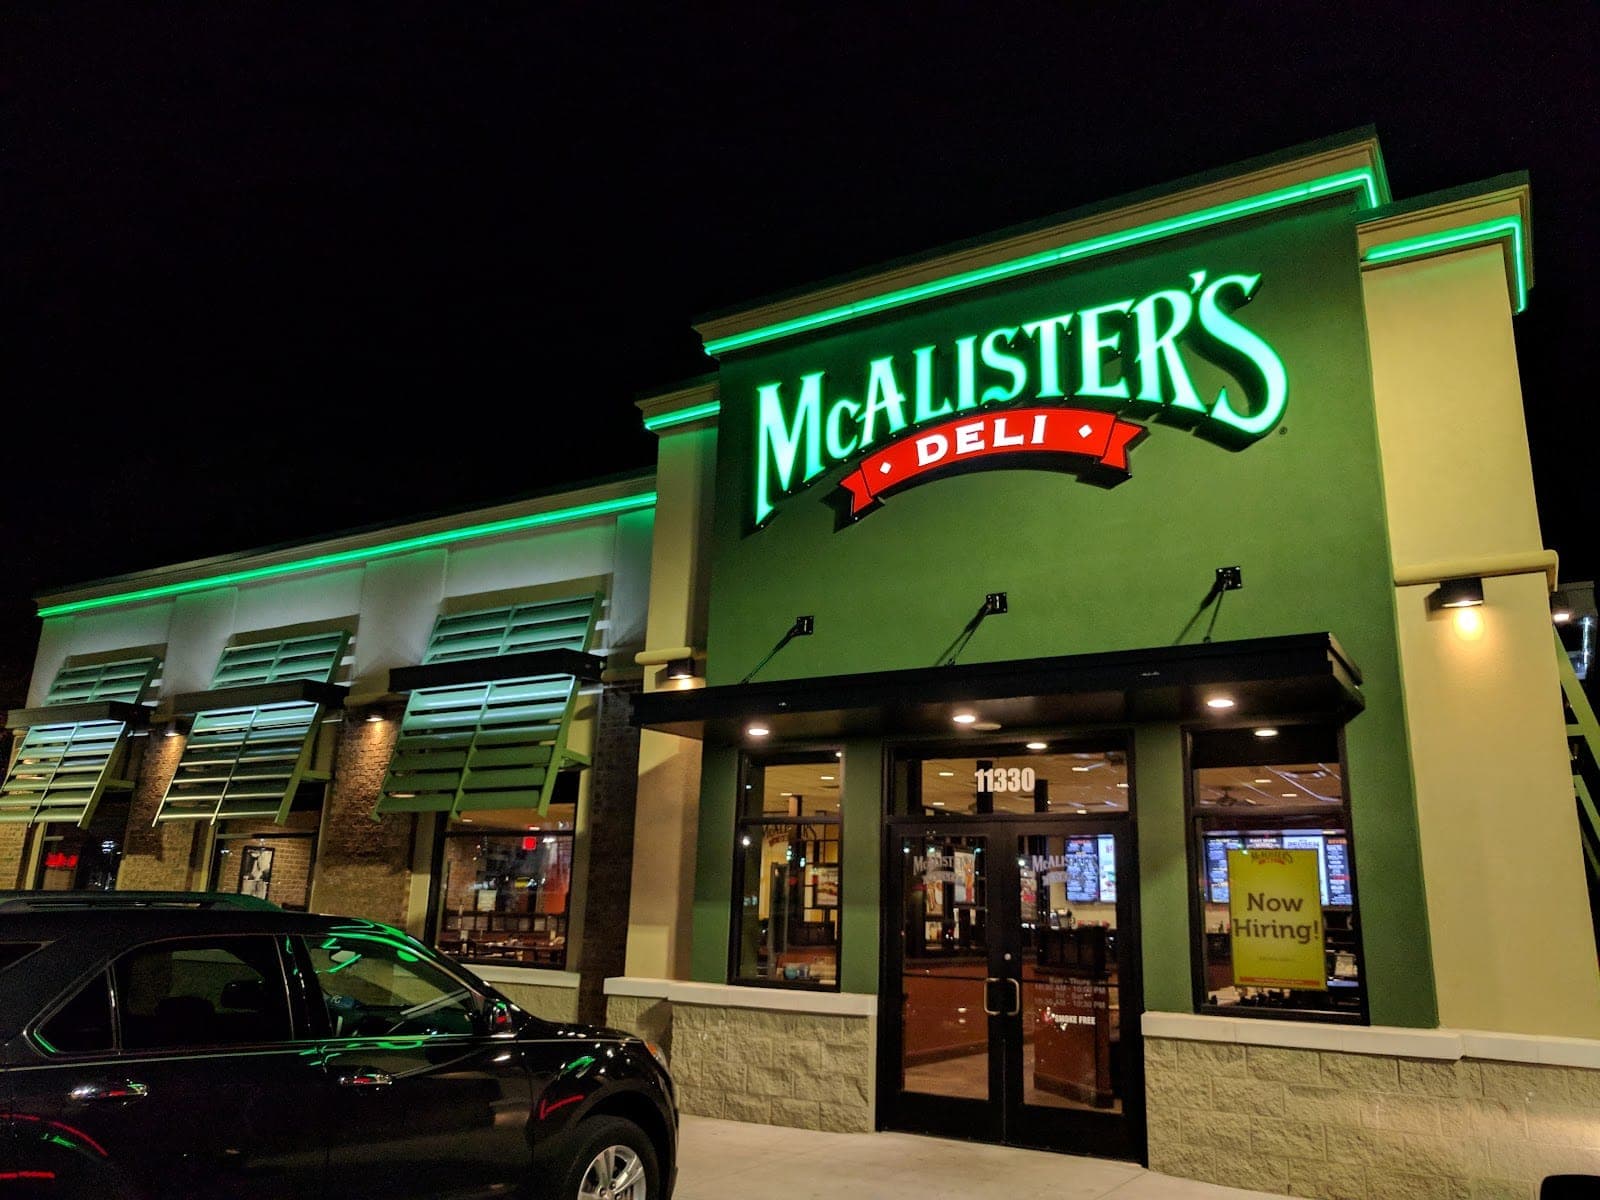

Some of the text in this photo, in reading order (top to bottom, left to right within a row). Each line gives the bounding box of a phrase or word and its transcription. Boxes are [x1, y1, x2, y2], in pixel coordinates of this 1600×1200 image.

[916, 414, 1048, 467] DELI
[975, 767, 1036, 793] 11330
[1246, 892, 1304, 912] Now
[1232, 918, 1320, 945] Hiring!
[1078, 1015, 1096, 1026] FREE
